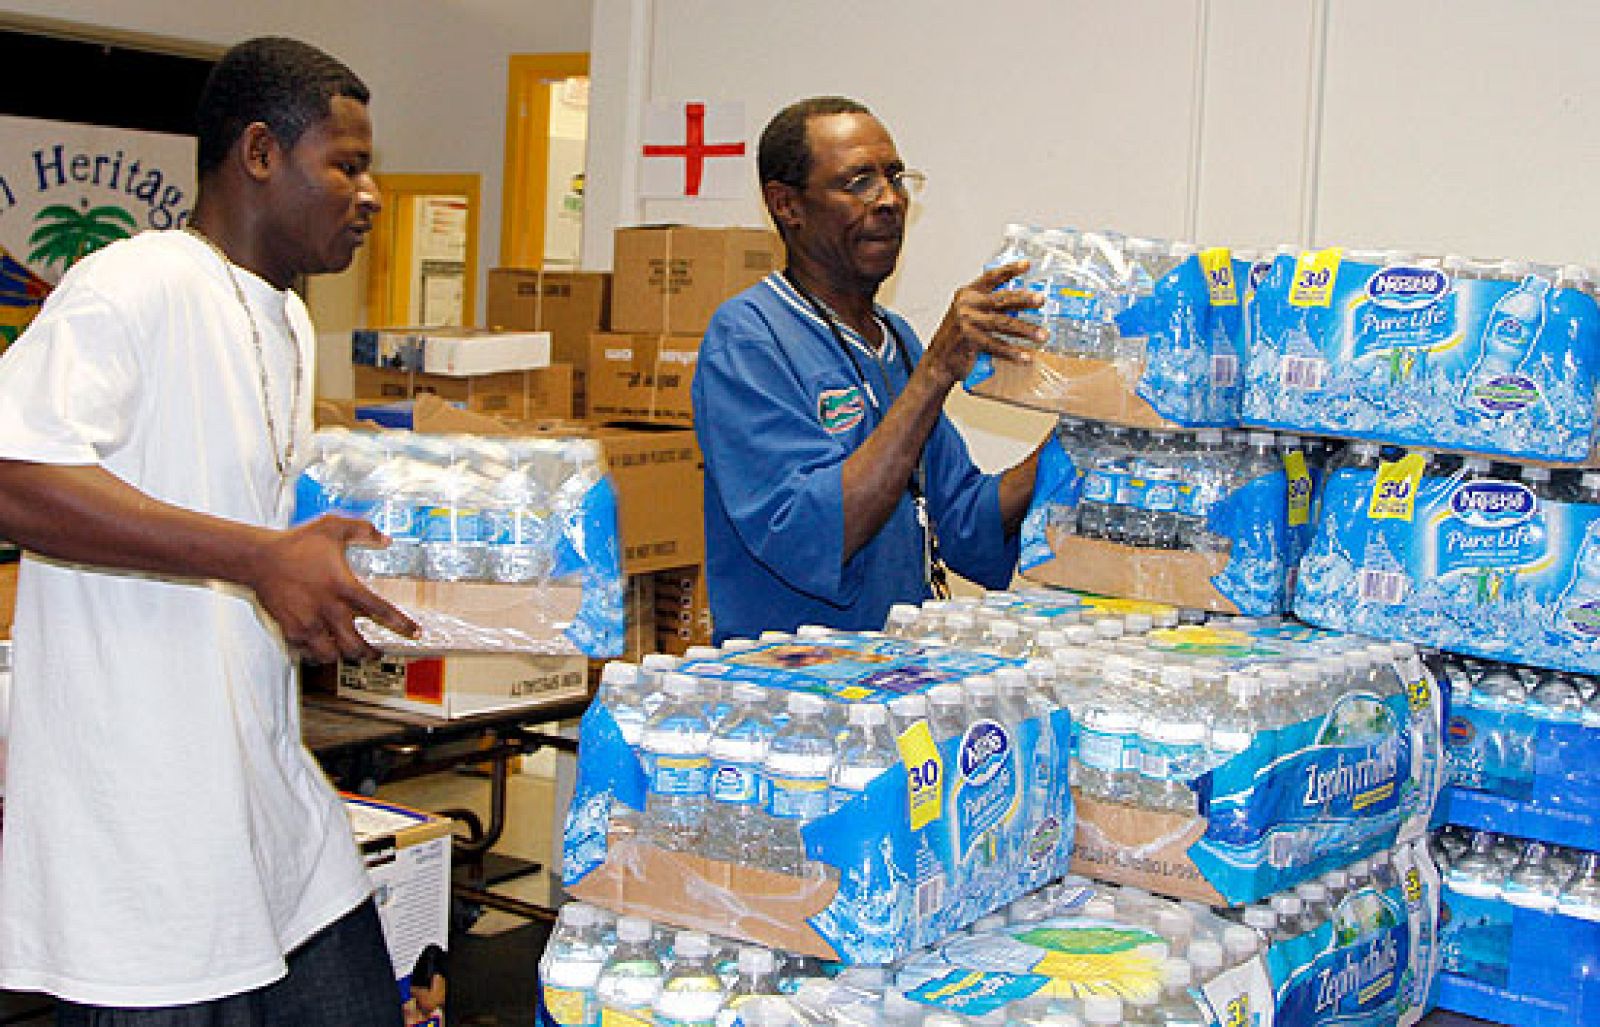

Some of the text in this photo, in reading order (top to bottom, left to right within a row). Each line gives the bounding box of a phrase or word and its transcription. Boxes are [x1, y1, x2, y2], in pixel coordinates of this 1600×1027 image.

[1298, 269, 1331, 288] 30
[1361, 309, 1448, 334] Pure Life
[1446, 530, 1492, 551] Pure
[909, 759, 938, 792] 30
